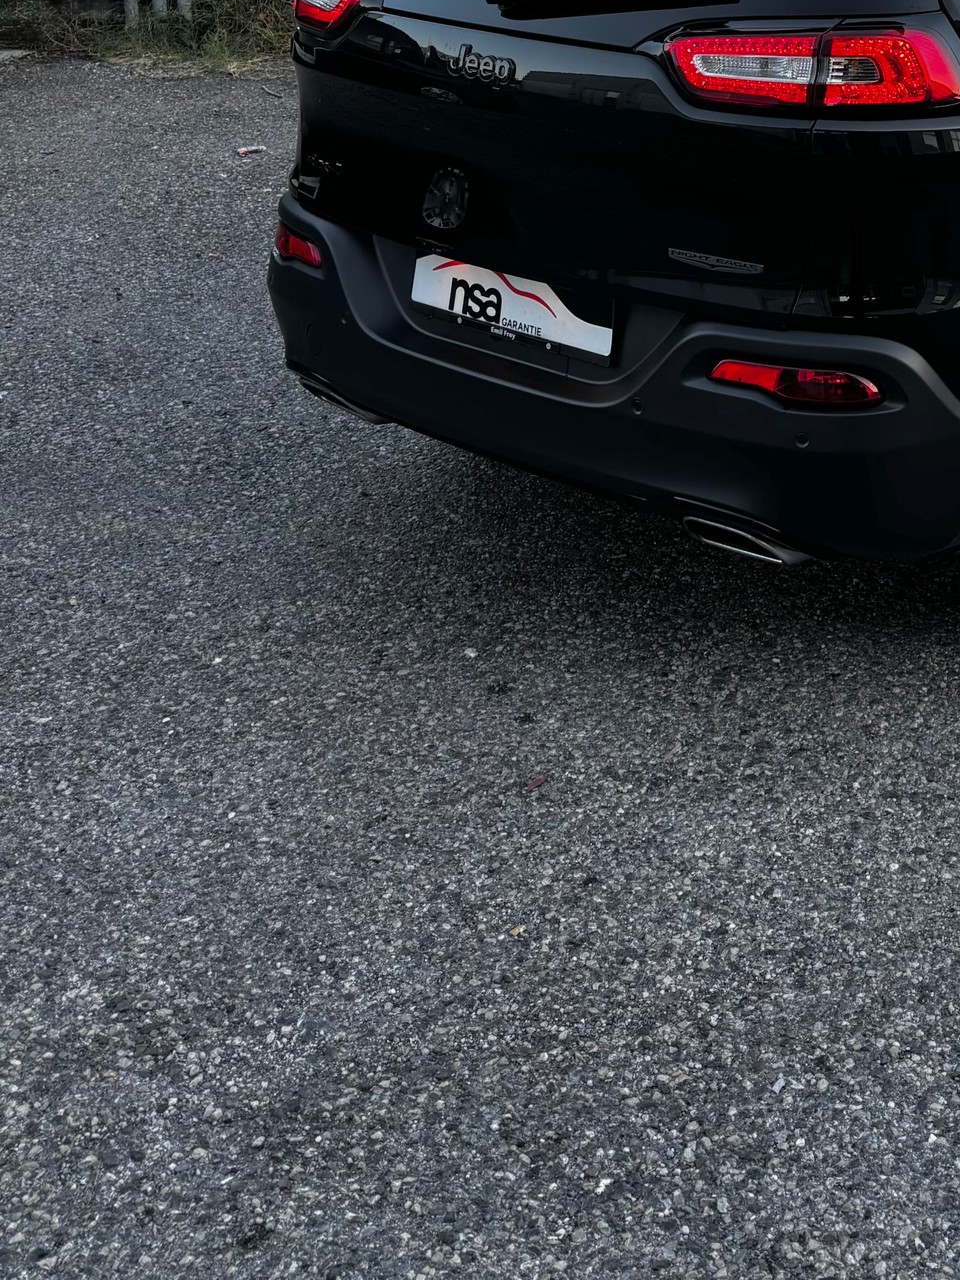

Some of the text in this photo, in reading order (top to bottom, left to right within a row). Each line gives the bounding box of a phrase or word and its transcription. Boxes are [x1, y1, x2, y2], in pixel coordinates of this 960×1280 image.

[447, 44, 516, 86] Jeep
[671, 250, 759, 272] NIGHT EAGLE
[448, 277, 502, 324] nsa
[490, 326, 516, 341] Emil Frey
[501, 317, 542, 337] GARANTIE
